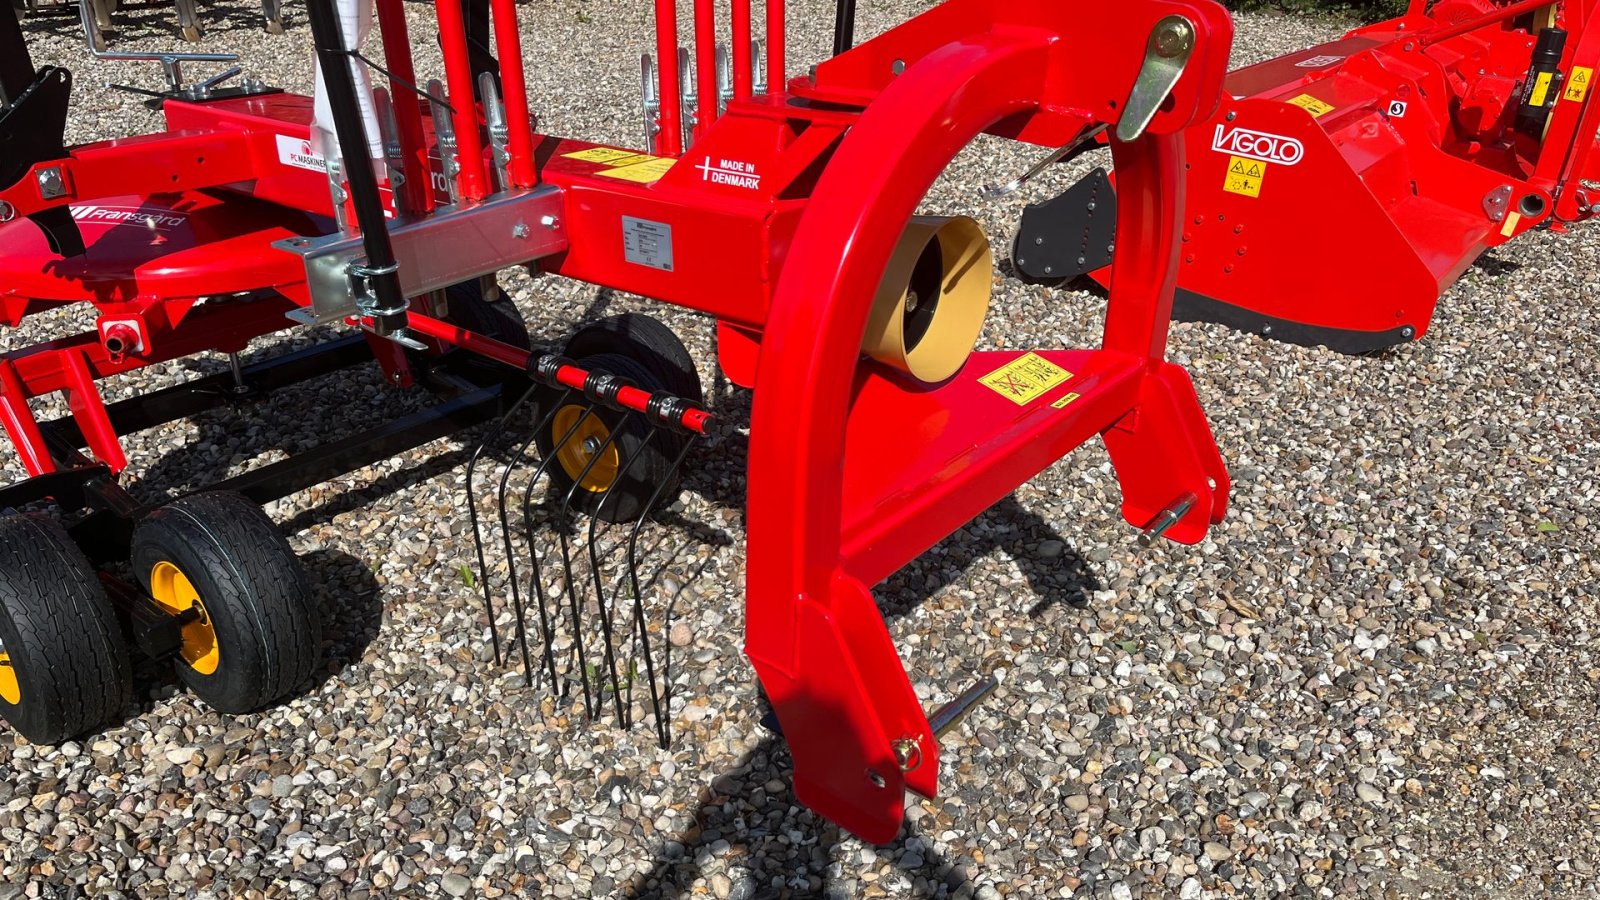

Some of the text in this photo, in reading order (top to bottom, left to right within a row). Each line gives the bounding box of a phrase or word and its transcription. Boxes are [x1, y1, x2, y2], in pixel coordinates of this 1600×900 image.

[720, 159, 755, 173] MADE IN
[711, 172, 759, 190] DENMARK
